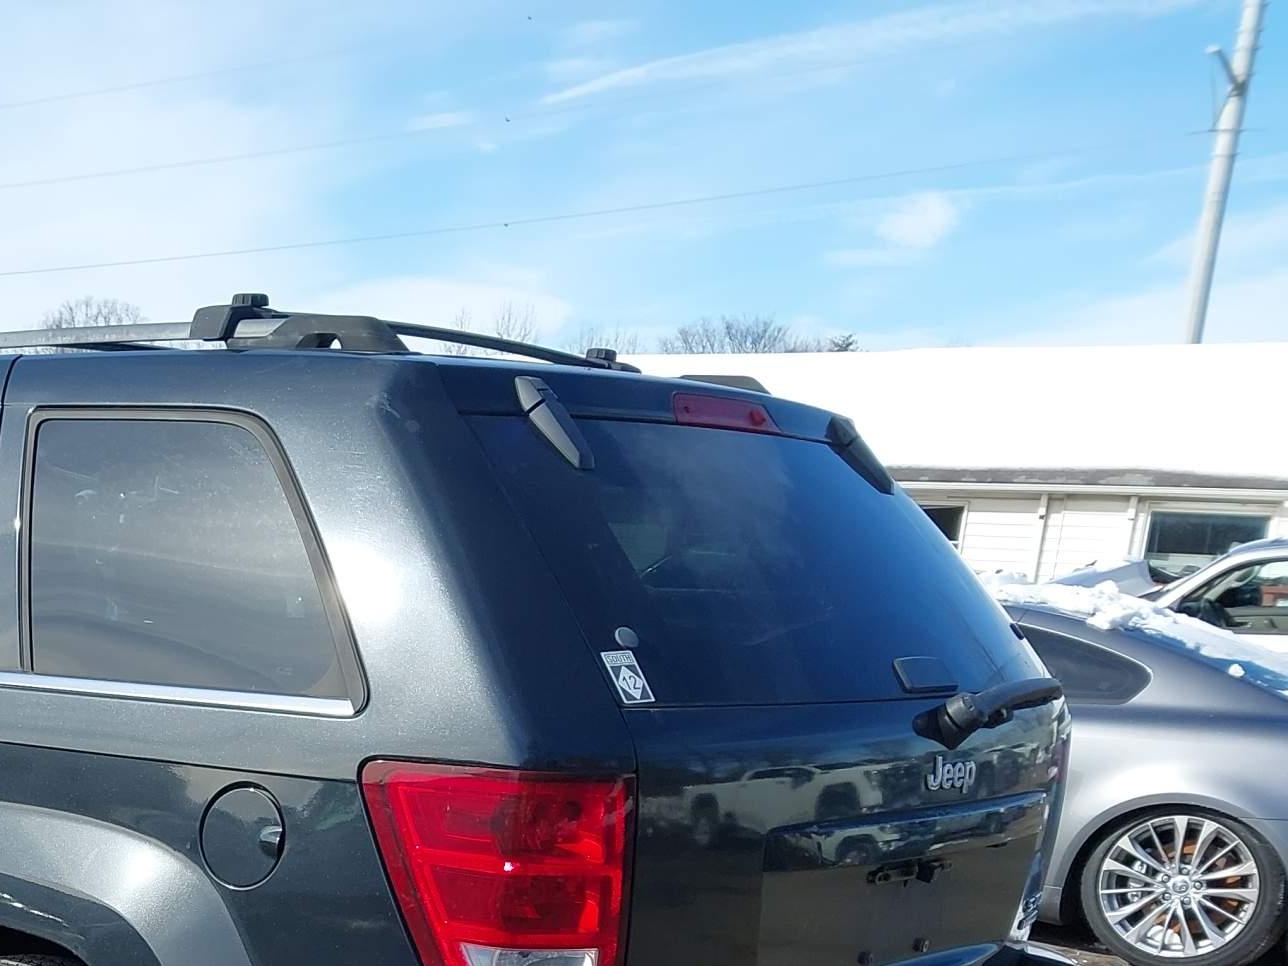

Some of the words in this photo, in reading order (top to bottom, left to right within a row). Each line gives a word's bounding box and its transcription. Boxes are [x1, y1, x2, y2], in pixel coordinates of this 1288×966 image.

[605, 654, 633, 664] SOUTH
[622, 675, 641, 690] 12
[926, 755, 976, 794] Jeep
